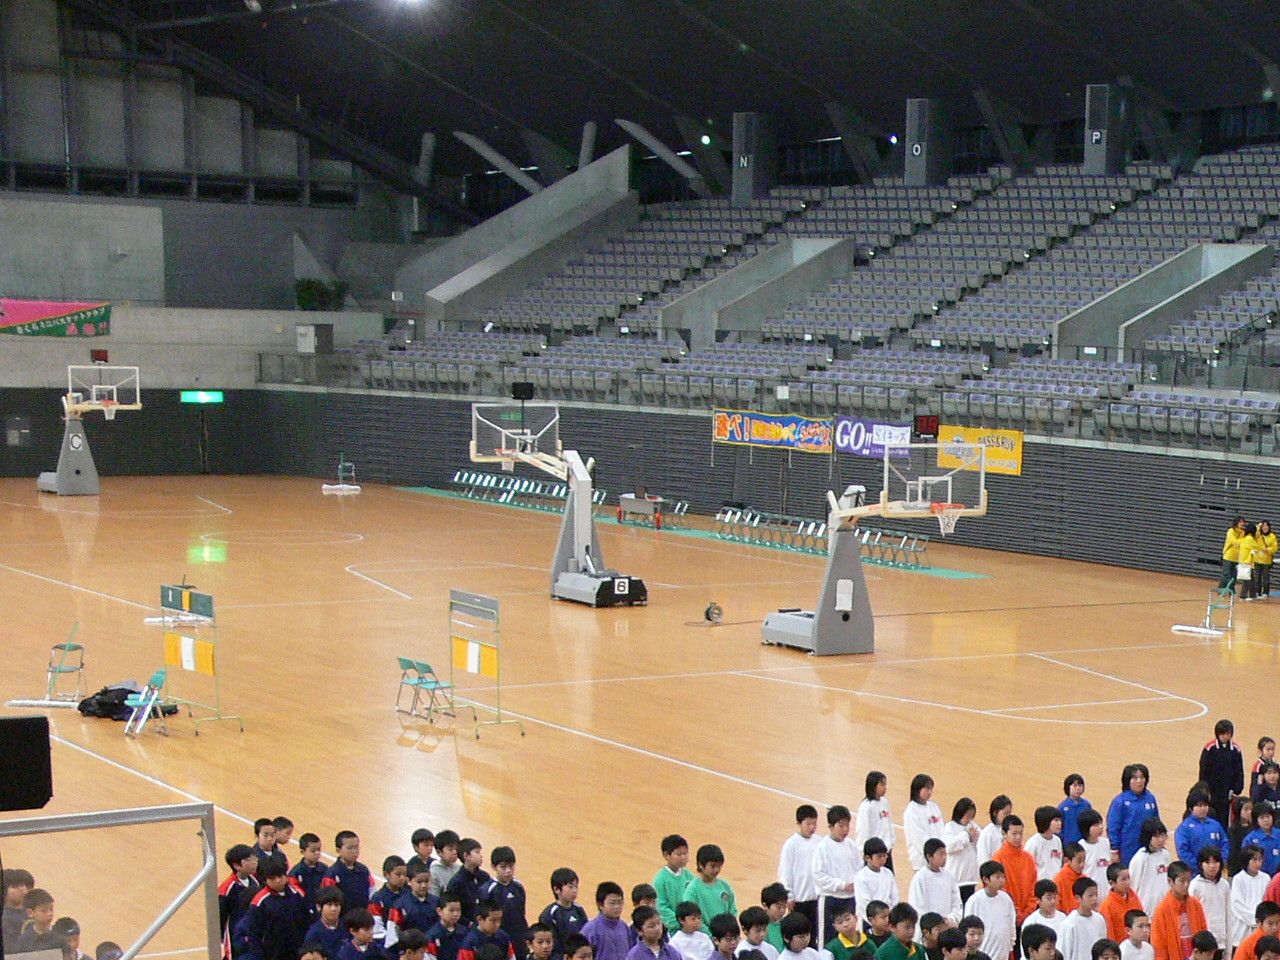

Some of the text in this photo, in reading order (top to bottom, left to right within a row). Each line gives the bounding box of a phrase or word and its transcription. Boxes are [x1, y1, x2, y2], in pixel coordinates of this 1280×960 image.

[1092, 131, 1101, 144] P
[740, 156, 748, 167] N
[70, 434, 82, 450] C
[617, 580, 627, 592] 6
